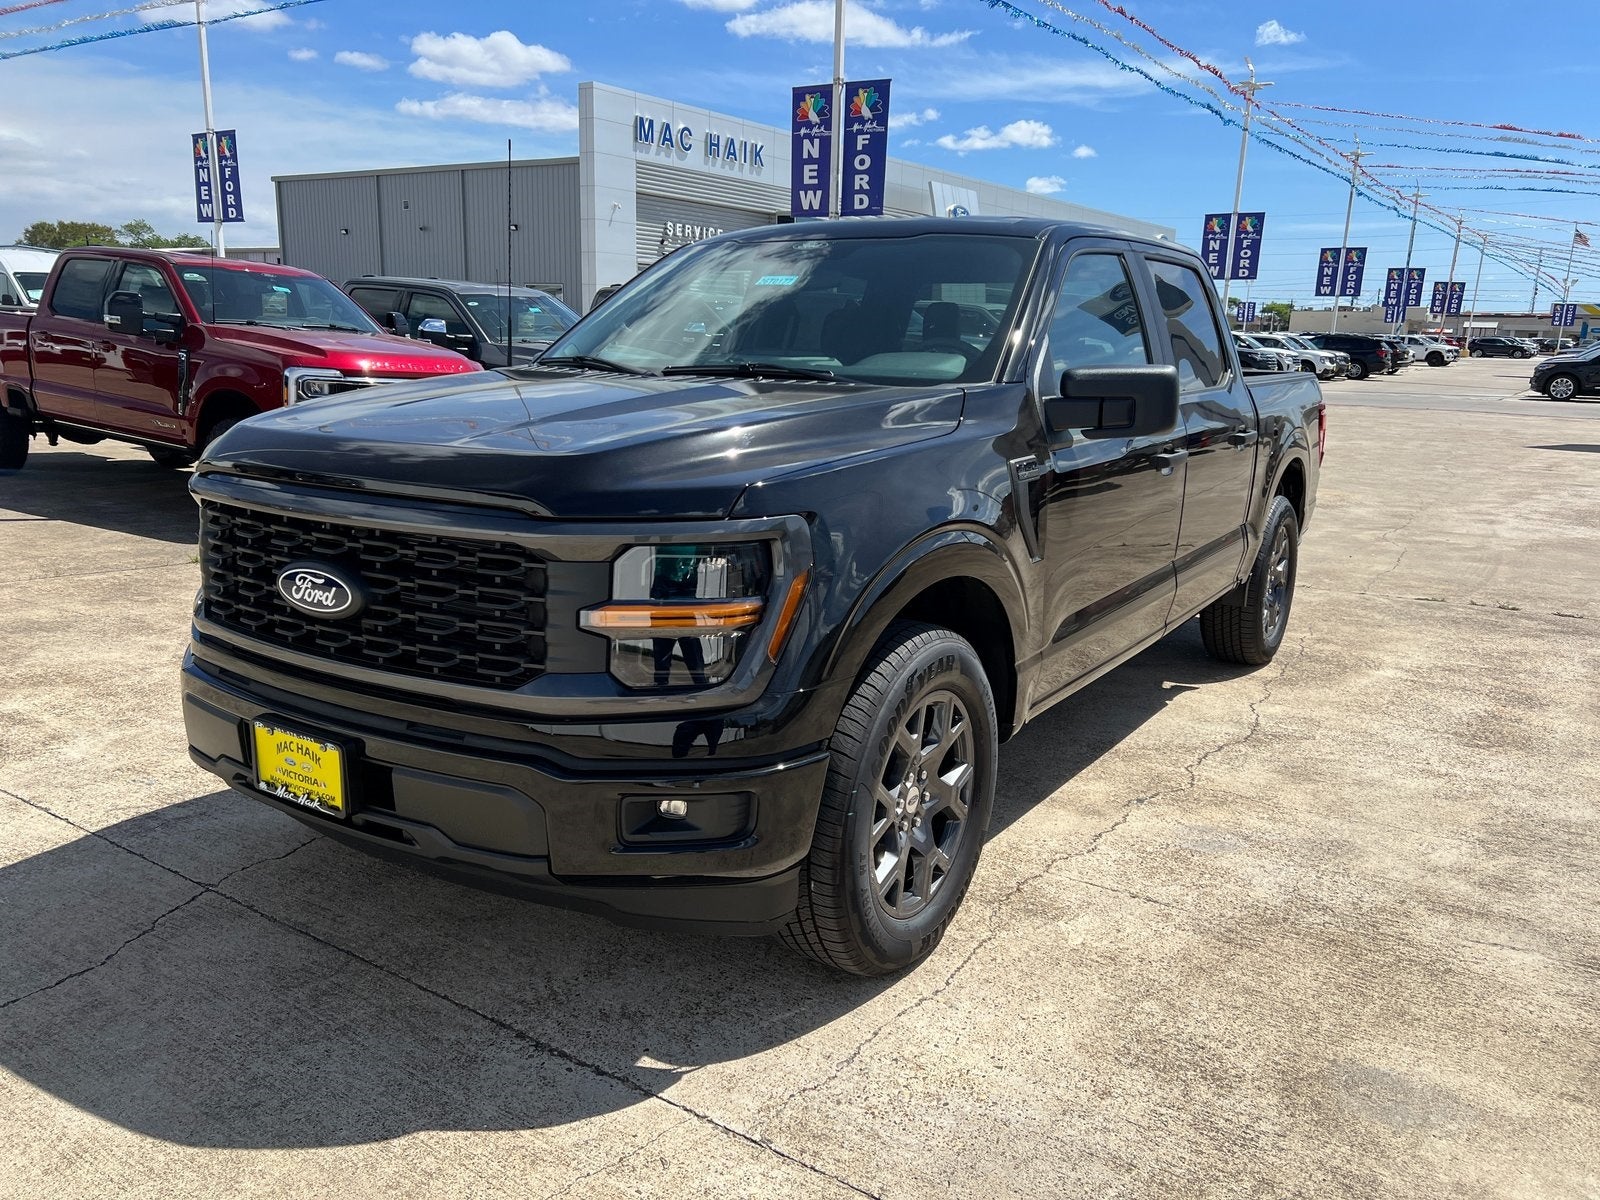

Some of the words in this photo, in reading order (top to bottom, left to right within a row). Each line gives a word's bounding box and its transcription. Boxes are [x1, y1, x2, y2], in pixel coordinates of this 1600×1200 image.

[636, 115, 693, 152] MAC
[706, 131, 765, 168] HAIK
[799, 138, 822, 210] NEW
[854, 134, 871, 210] FORD
[199, 168, 213, 217] NEW
[225, 167, 237, 218] FORD
[1208, 240, 1220, 276] NEW
[1238, 240, 1252, 277] FORD
[1320, 267, 1331, 294] NEW
[1346, 267, 1357, 294] FORD
[1388, 283, 1398, 304] NEW
[1409, 283, 1417, 305] FORD
[1433, 295, 1442, 312] NEW
[292, 574, 337, 606] Ford
[276, 741, 294, 755] MAC
[297, 743, 322, 767] HAIK
[281, 767, 320, 788] VICTORIA
[274, 785, 298, 802] Mac
